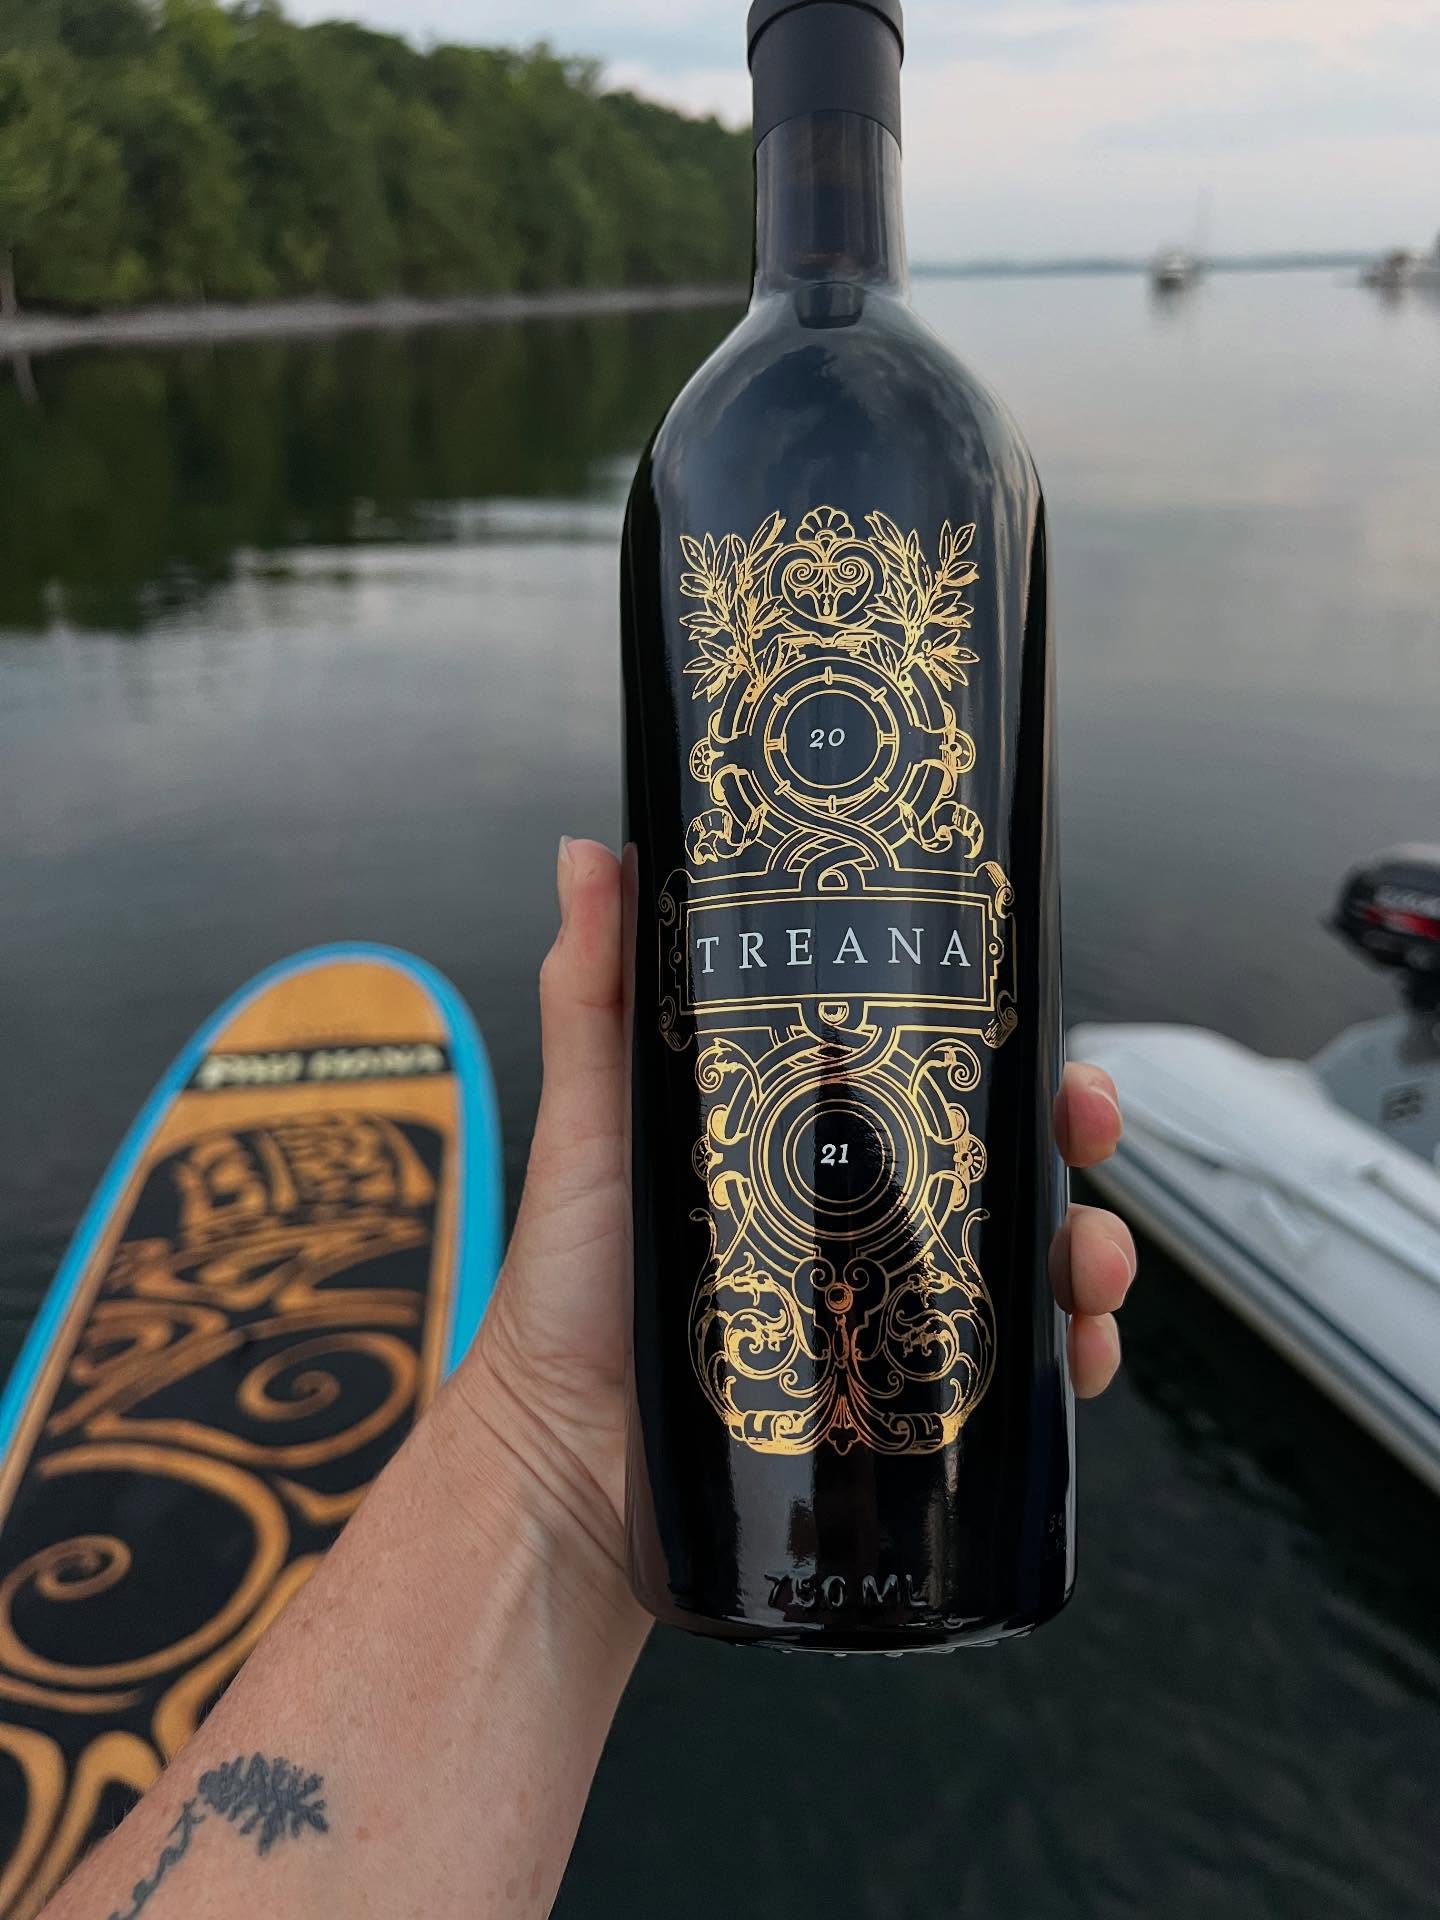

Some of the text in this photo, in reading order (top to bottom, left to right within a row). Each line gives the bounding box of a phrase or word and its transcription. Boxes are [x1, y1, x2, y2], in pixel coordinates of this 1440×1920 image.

[809, 728, 846, 750] 20
[696, 926, 972, 974] TREANA
[820, 1143, 849, 1167] 21
